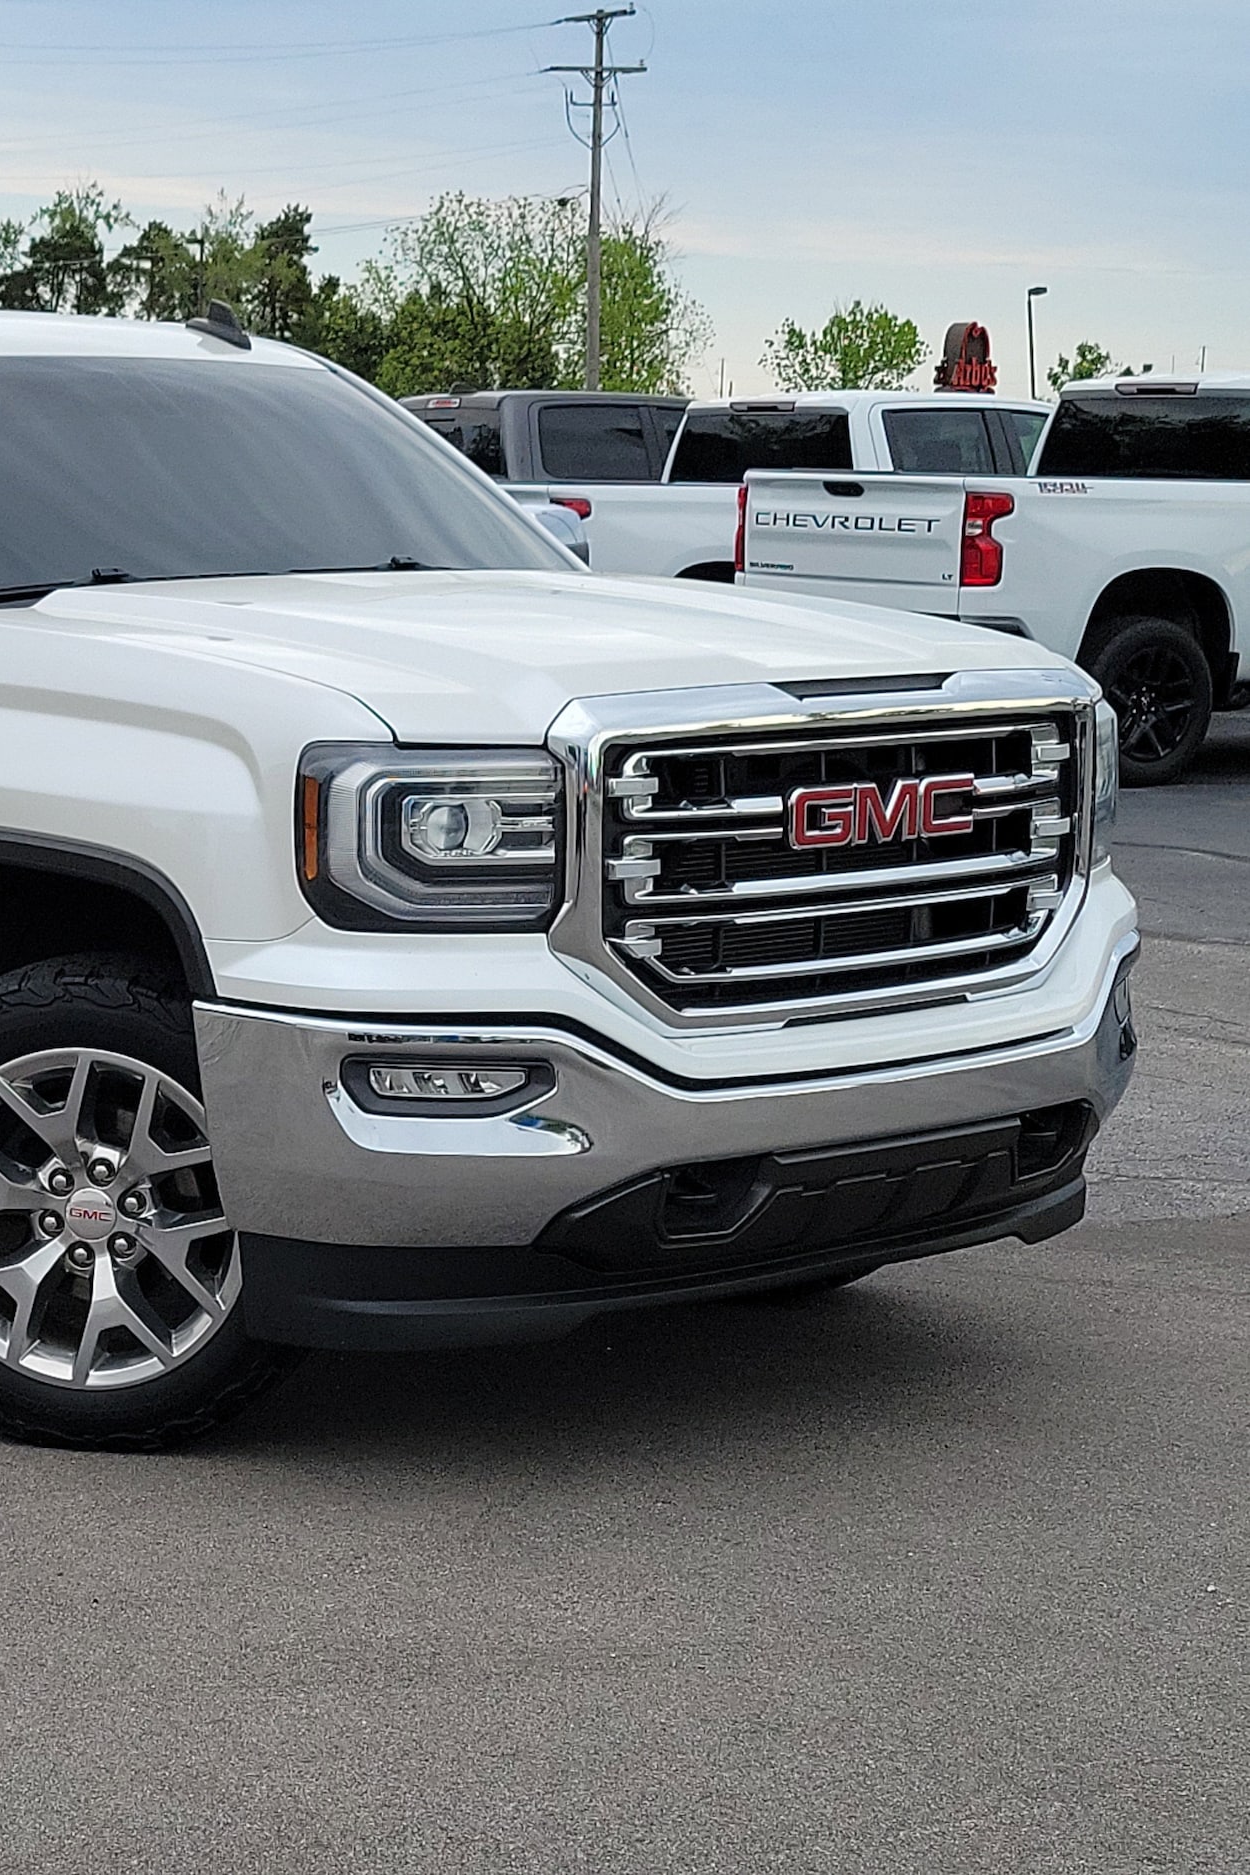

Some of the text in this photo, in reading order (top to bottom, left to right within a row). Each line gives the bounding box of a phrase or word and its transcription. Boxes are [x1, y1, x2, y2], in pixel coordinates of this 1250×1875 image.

[755, 511, 941, 533] CHEVROLET
[941, 573, 954, 581] LT
[788, 773, 975, 850] GMC
[69, 1207, 112, 1222] GMC
